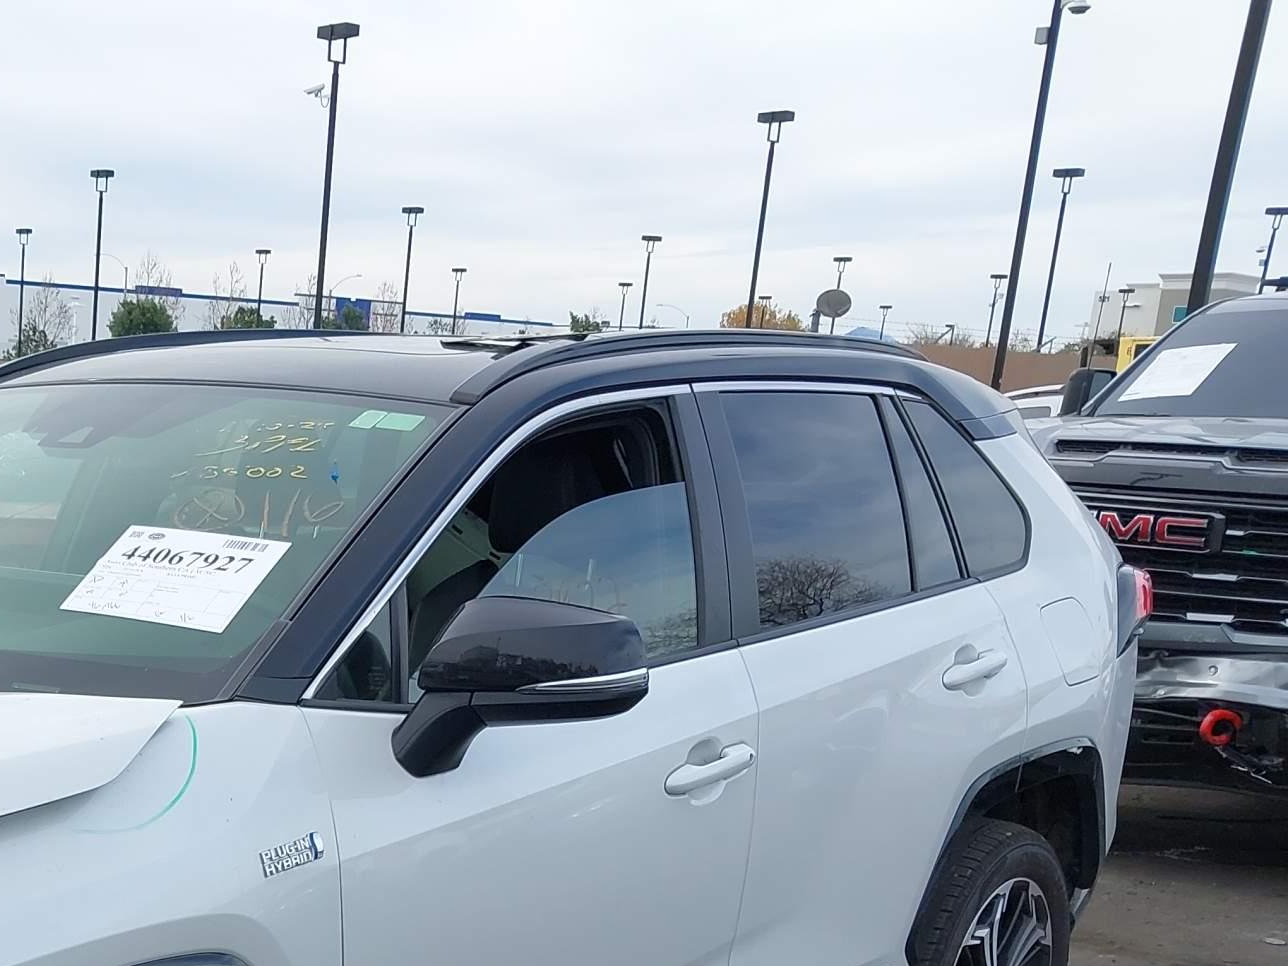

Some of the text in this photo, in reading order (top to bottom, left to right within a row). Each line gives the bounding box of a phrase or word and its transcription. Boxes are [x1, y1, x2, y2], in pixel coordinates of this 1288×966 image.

[1090, 509, 1209, 548] MC
[121, 545, 254, 574] 44067927
[261, 836, 310, 863] PLUG-IN
[264, 851, 312, 876] HYBRID
